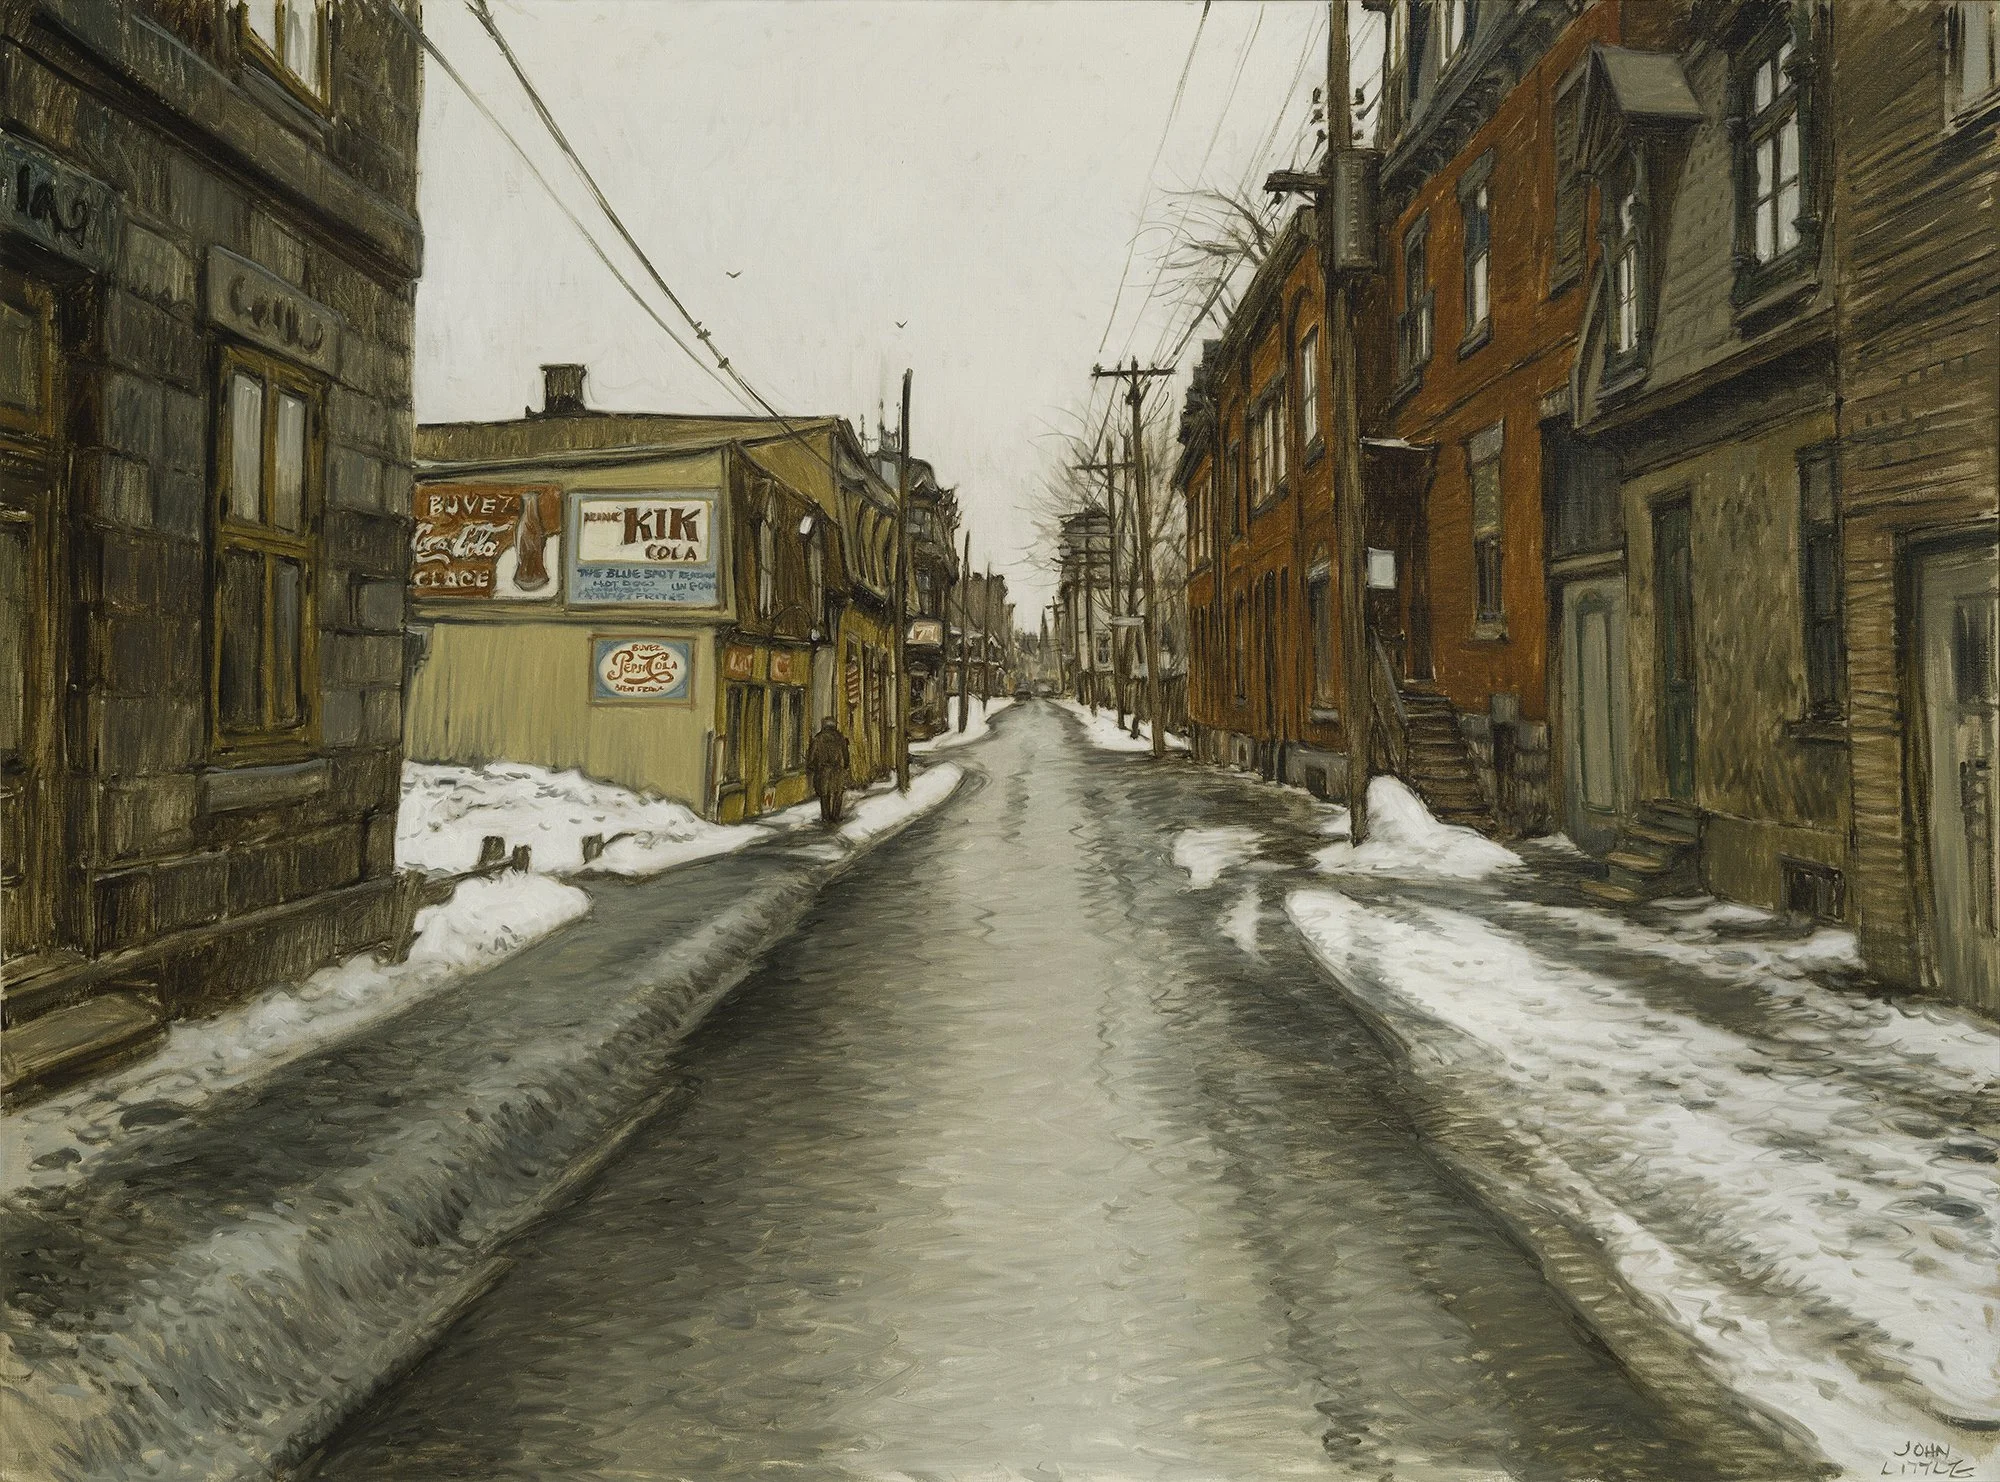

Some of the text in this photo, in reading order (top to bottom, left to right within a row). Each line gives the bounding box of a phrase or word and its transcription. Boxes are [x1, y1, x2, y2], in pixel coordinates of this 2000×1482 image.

[623, 507, 701, 546] KIK
[645, 543, 698, 561] COLA
[605, 568, 641, 579] BLUE
[643, 568, 677, 579] SPOT
[1893, 1440, 1951, 1459] JOHN
[1880, 1459, 1976, 1479] LITTLE
